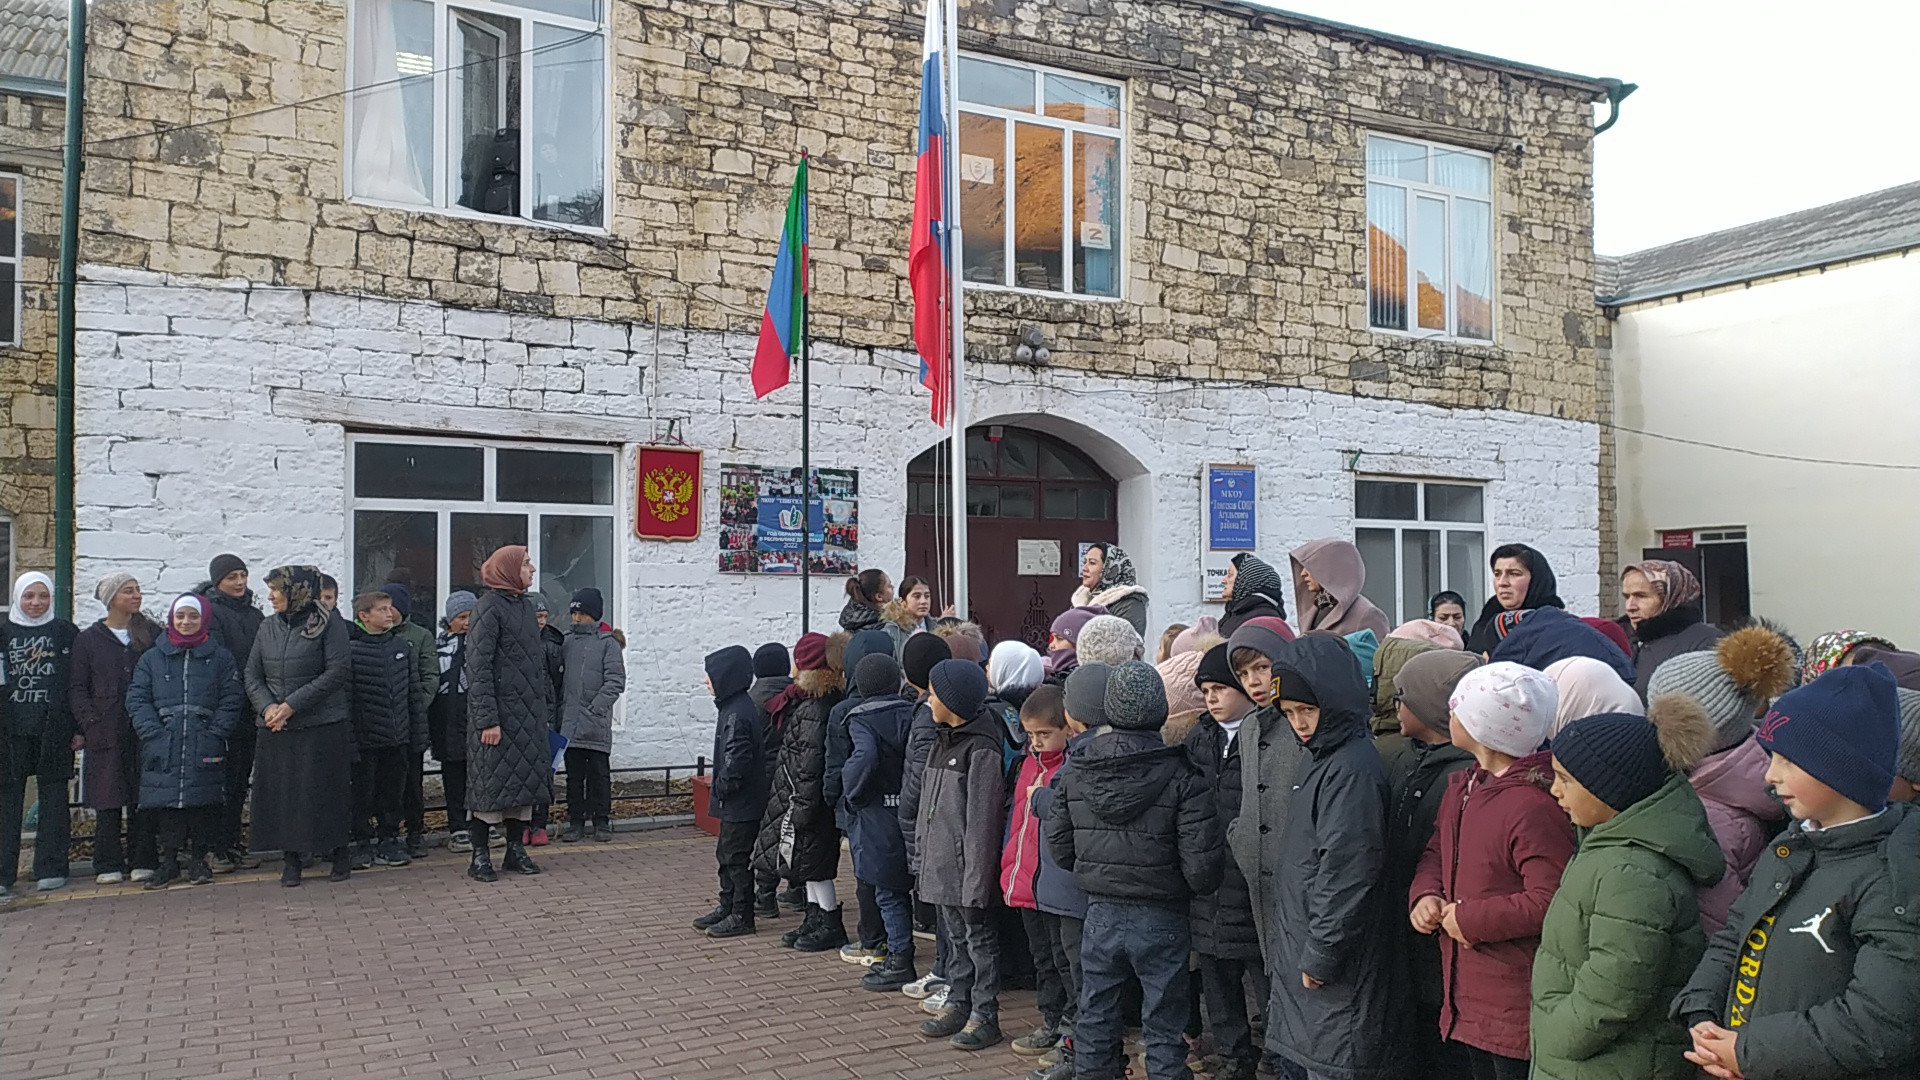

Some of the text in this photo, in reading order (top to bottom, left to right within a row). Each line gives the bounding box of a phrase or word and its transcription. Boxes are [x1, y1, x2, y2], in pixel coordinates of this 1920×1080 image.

[1221, 490, 1243, 498] МКОУ
[9, 650, 25, 663] BE
[19, 676, 41, 689] OF
